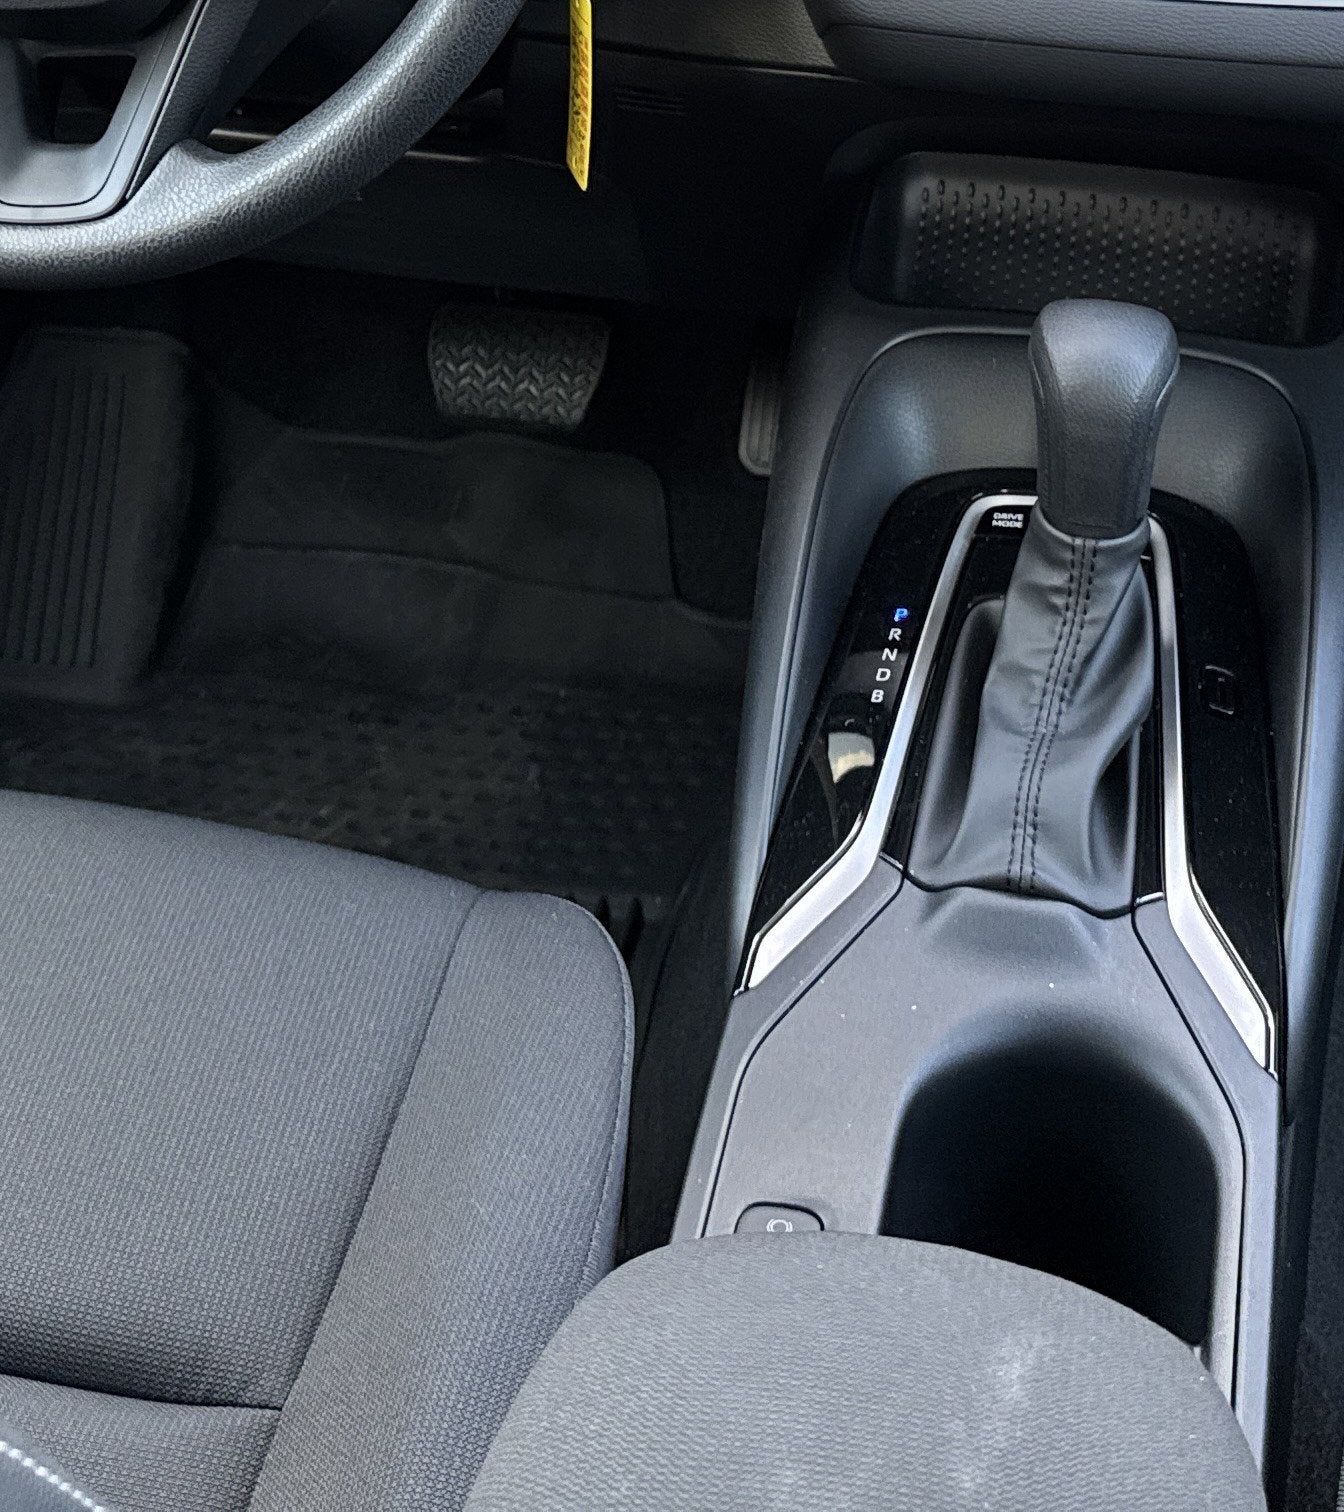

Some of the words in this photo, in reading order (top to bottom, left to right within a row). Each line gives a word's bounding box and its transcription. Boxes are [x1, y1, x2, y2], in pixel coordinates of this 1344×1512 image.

[993, 512, 1024, 521] DRIVE
[991, 520, 1024, 528] MODE
[894, 607, 909, 622] P
[888, 627, 902, 641] R
[881, 648, 898, 662] N
[875, 667, 891, 682] D
[870, 689, 885, 703] B
